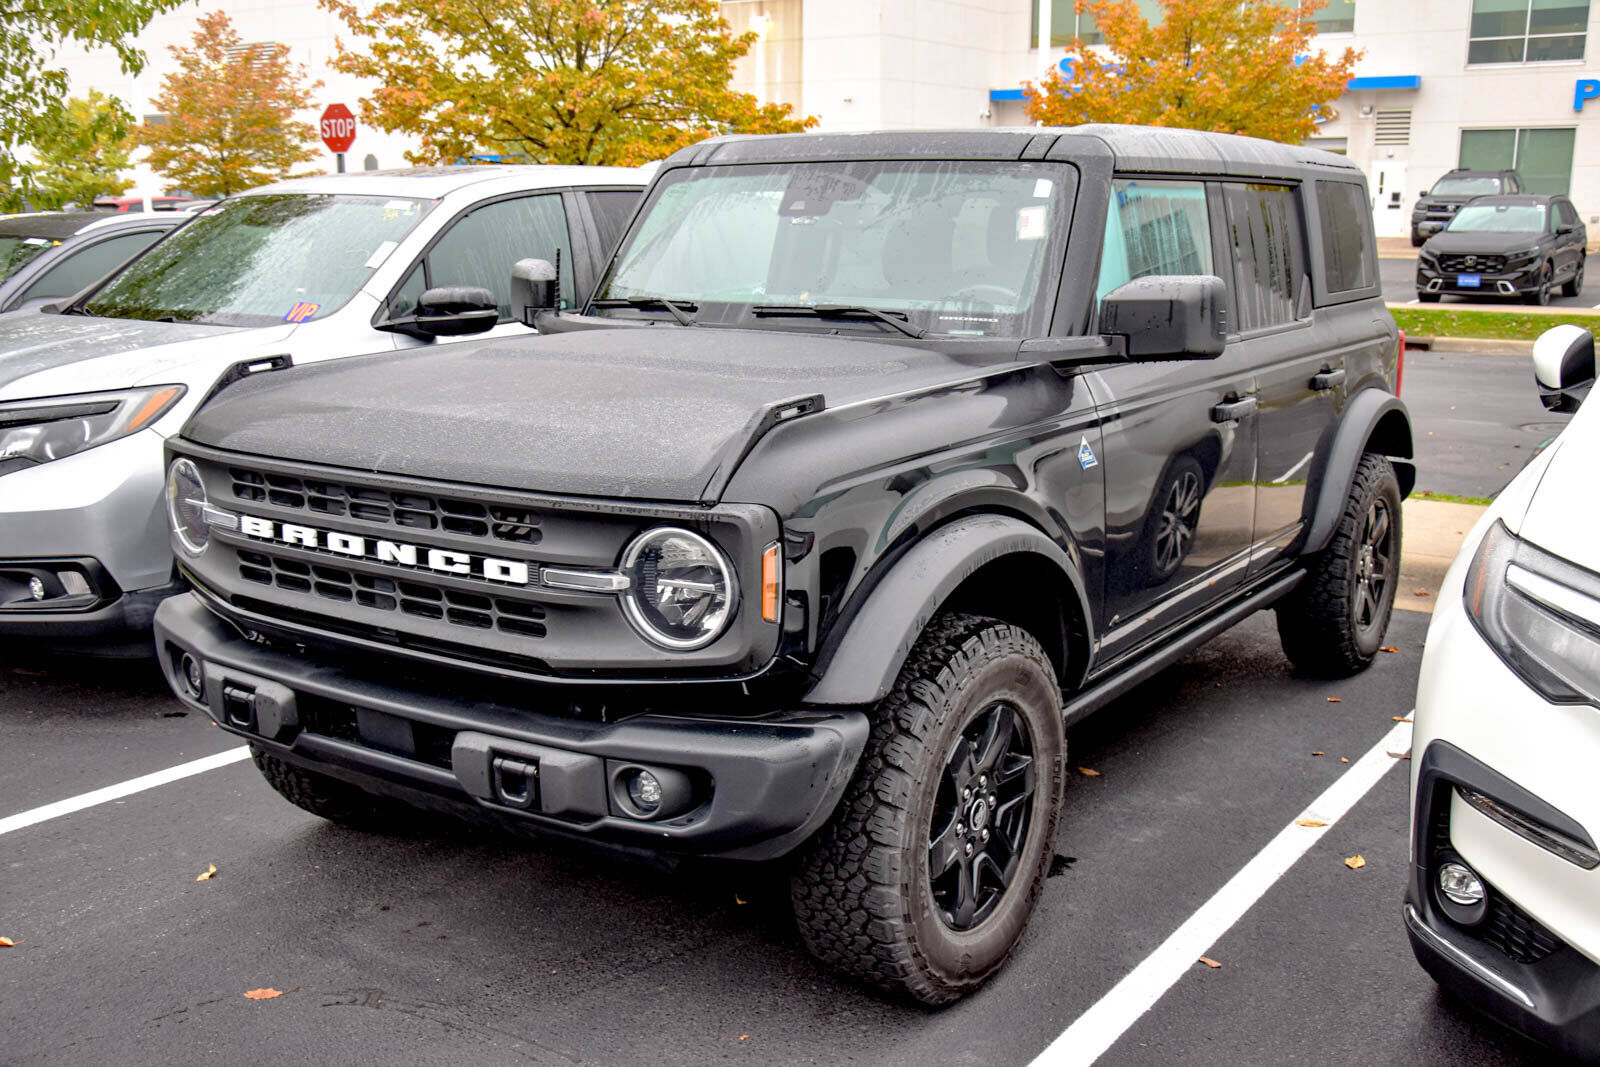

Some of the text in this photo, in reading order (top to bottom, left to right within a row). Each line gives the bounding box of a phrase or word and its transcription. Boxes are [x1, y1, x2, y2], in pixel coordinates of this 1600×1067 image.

[322, 118, 354, 138] STOP
[286, 302, 318, 322] VIP
[240, 515, 529, 584] BRONCO
